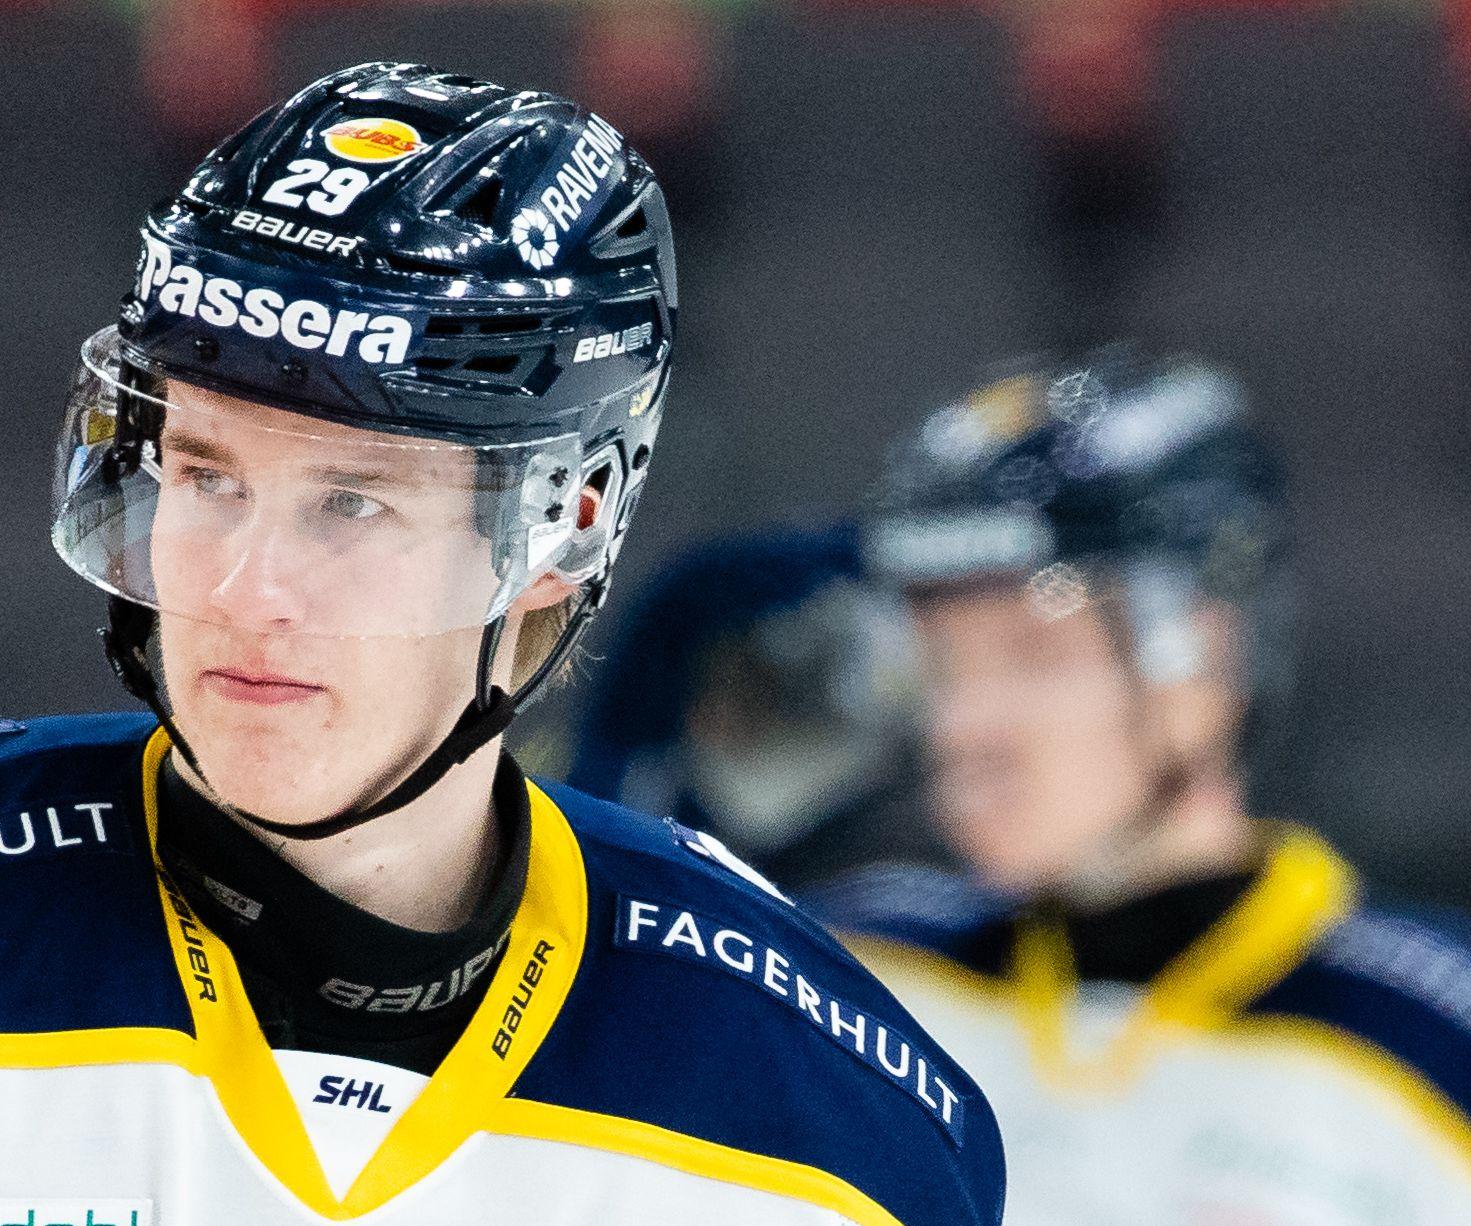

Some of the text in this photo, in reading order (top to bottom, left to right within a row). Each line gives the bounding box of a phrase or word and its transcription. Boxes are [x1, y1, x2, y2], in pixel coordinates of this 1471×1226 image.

[262, 158, 370, 216] 29
[540, 112, 624, 231] RAVEMA
[141, 234, 413, 364] Passera
[628, 899, 960, 1124] FAGERHULT
[312, 1074, 392, 1113] SHL
